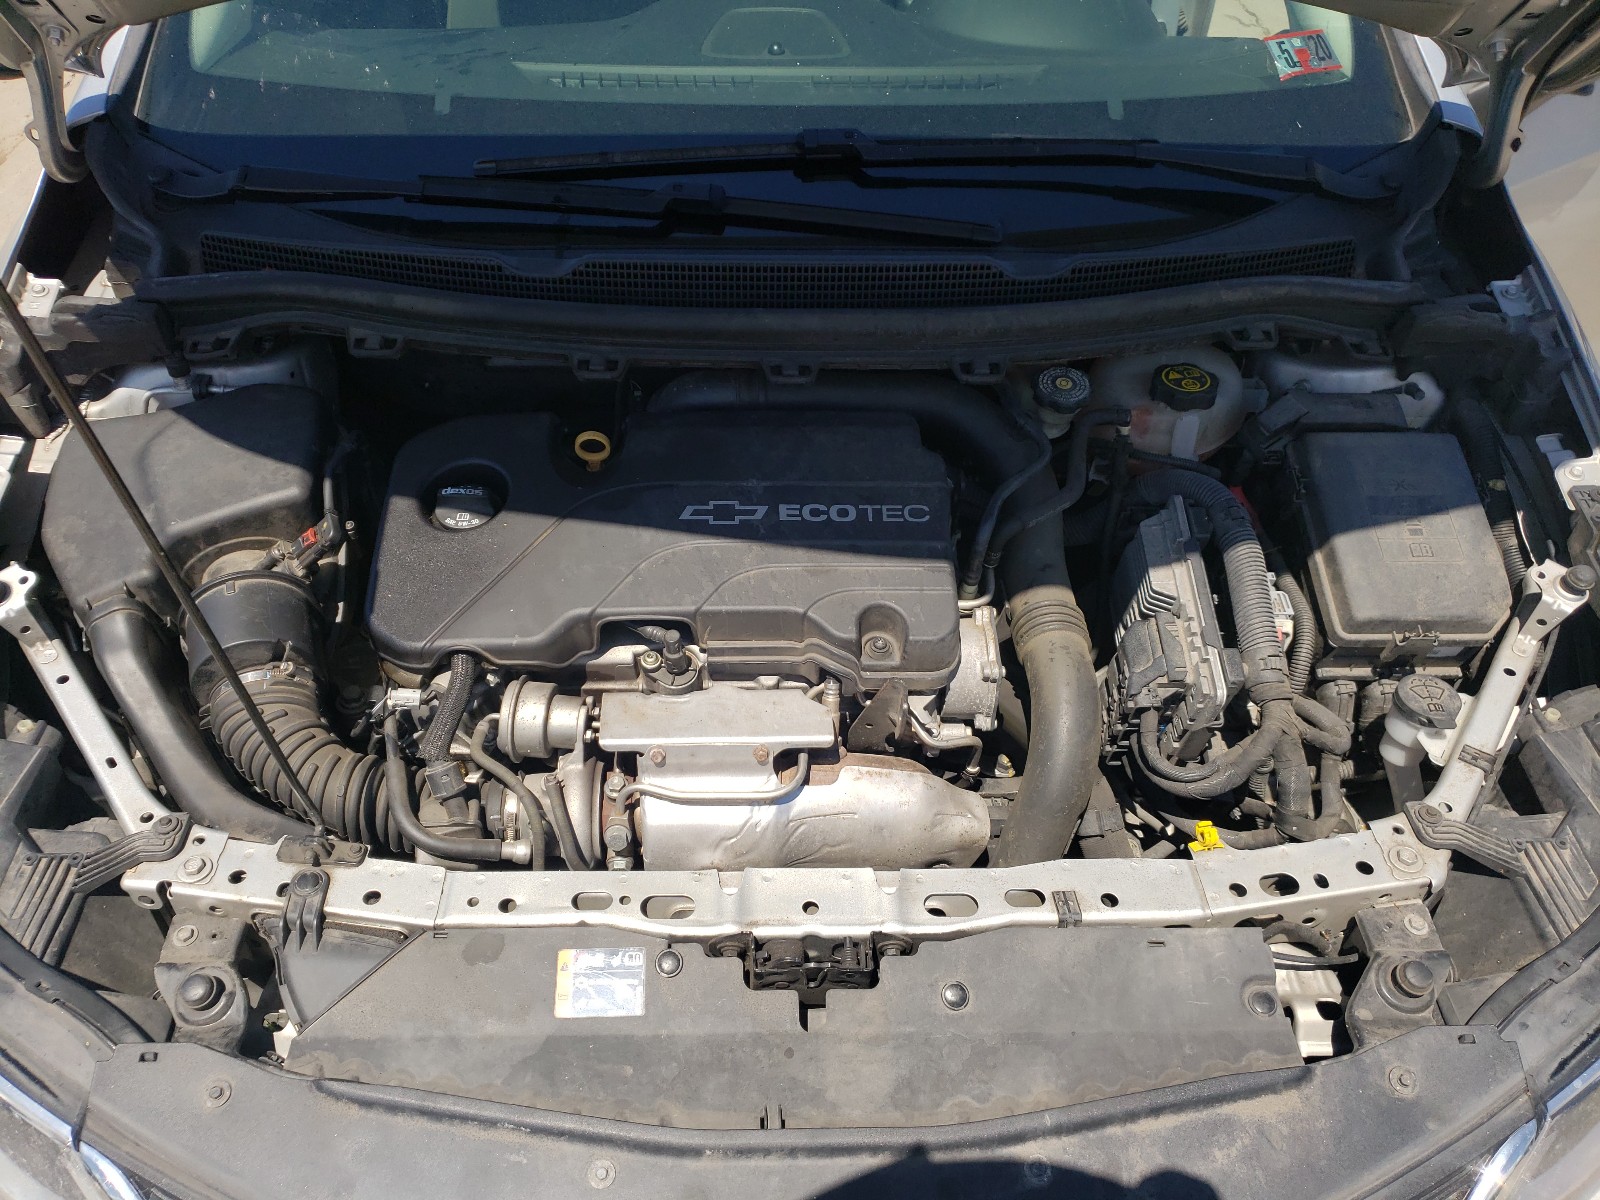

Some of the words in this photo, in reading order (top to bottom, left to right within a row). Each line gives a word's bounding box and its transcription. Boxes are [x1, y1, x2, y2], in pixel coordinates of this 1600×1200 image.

[1276, 40, 1297, 69] 5
[1307, 33, 1333, 61] 20
[441, 486, 484, 496] dexos
[778, 503, 931, 522] ECOTEC
